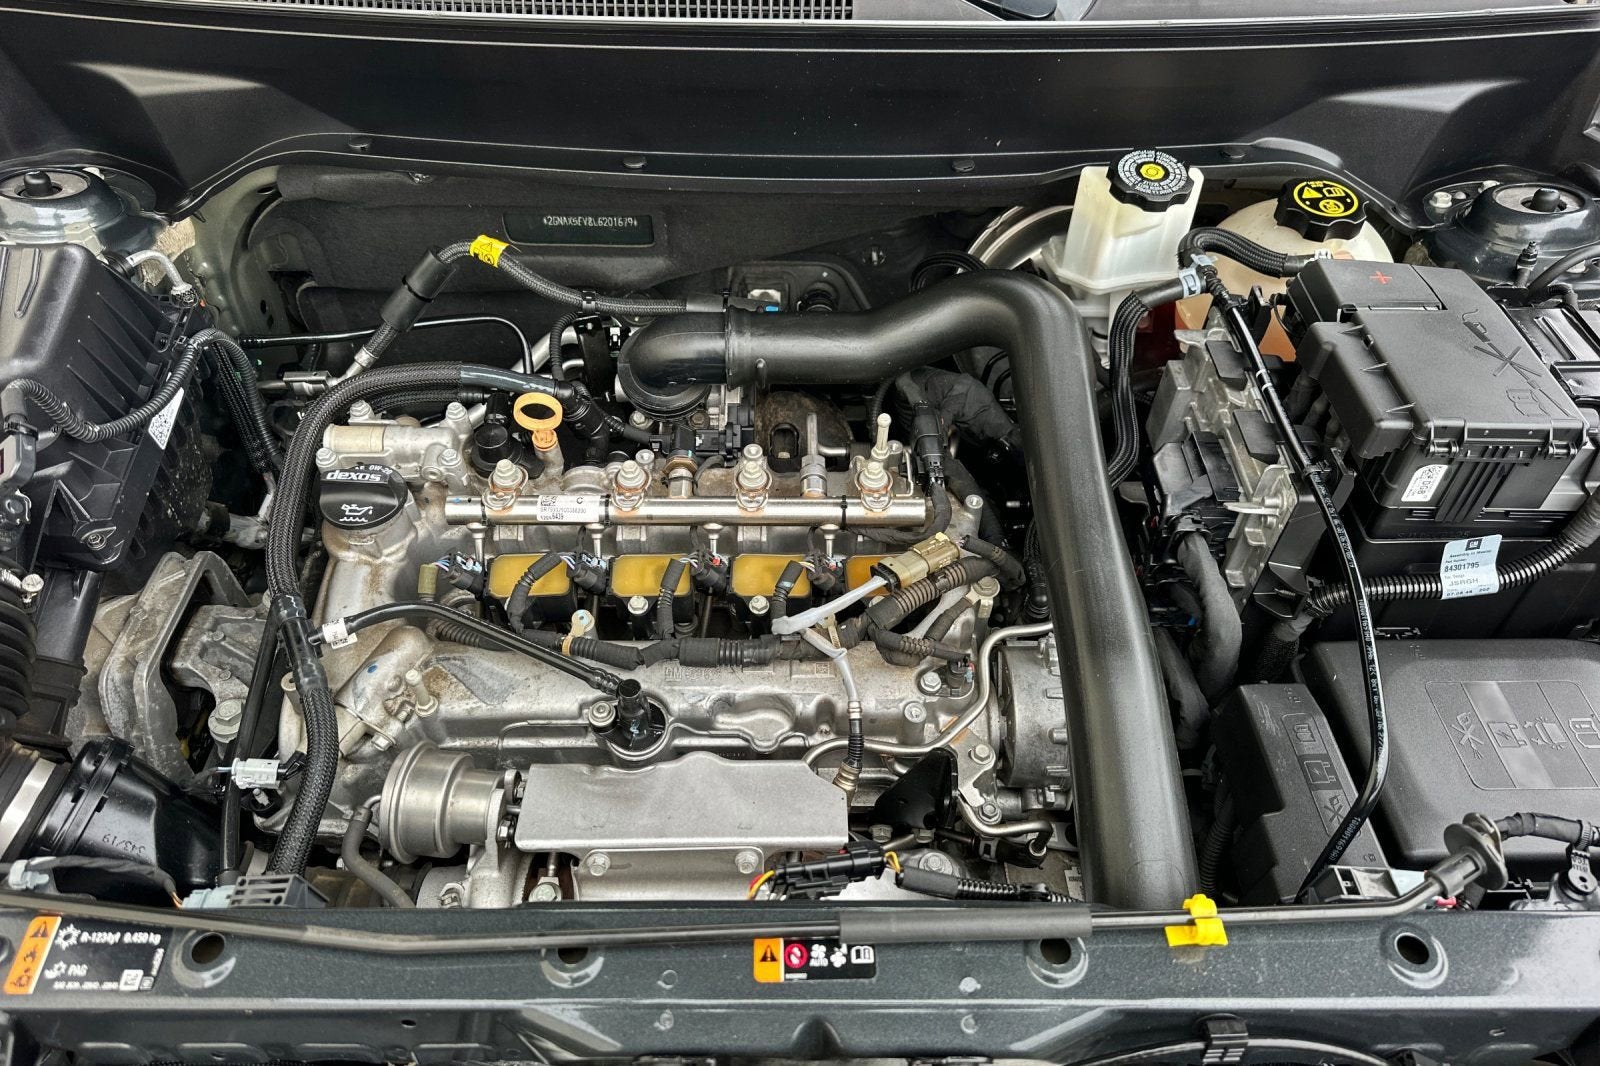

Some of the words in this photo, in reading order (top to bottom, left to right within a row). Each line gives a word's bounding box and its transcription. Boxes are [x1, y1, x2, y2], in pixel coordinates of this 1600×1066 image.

[326, 469, 382, 481] dexos
[368, 464, 393, 475] 0W-20
[1444, 561, 1480, 573] 84301795
